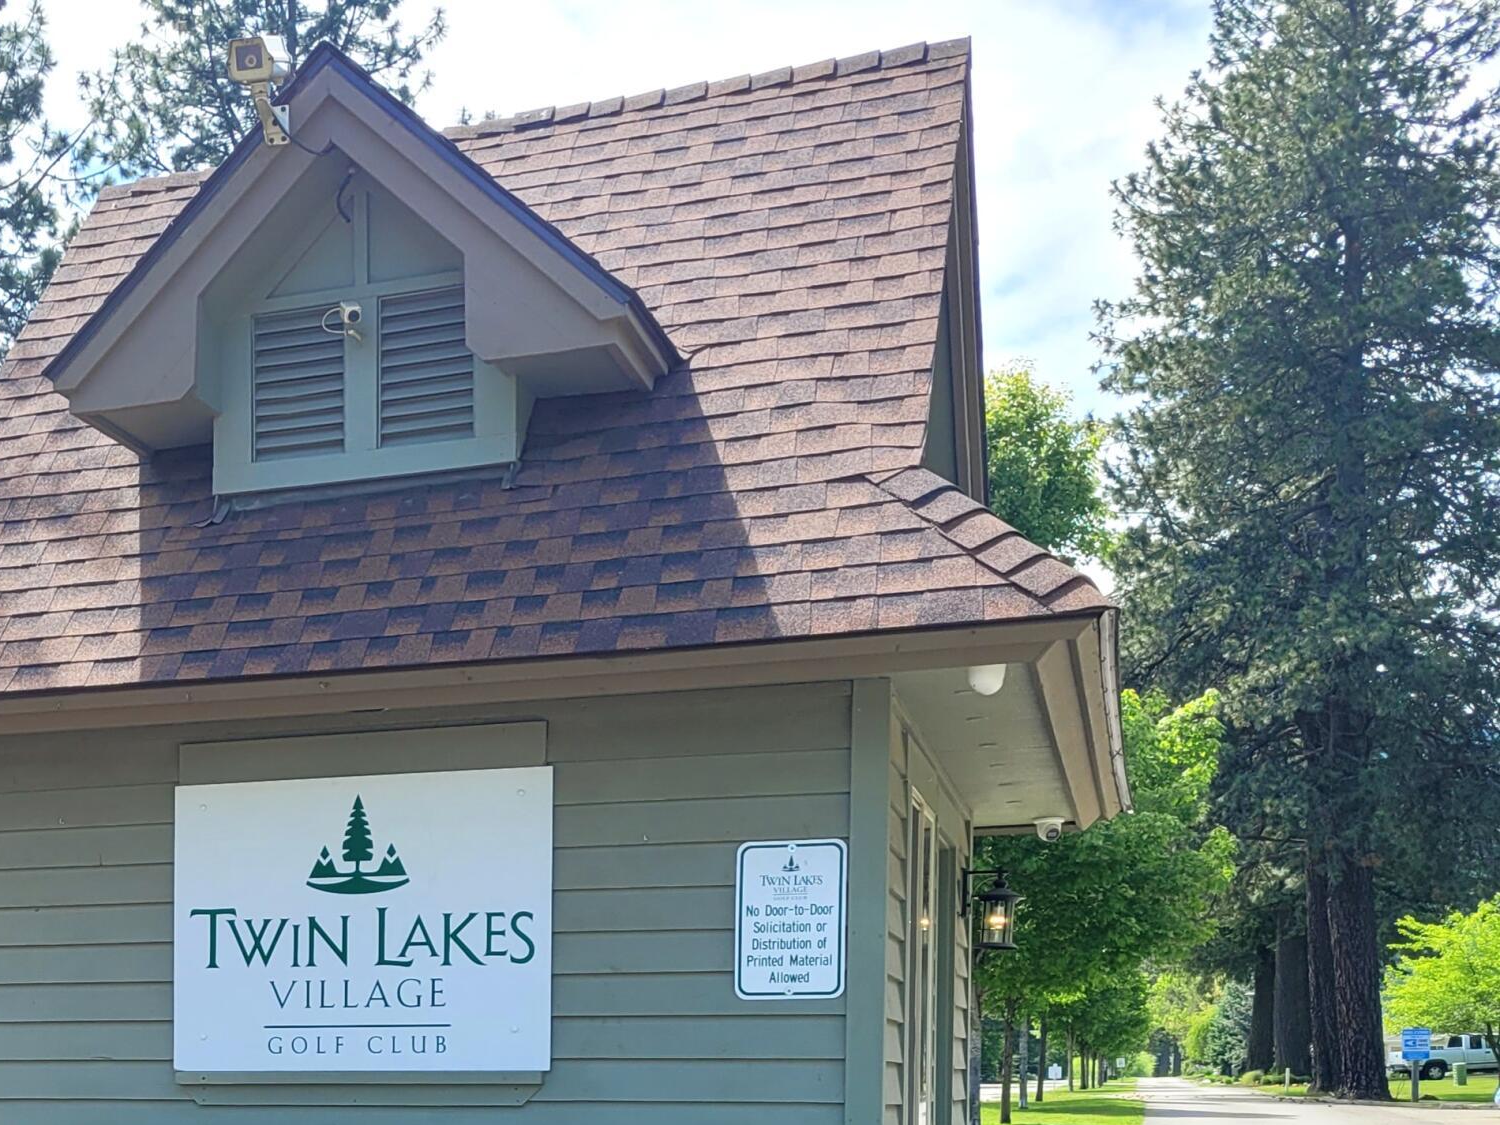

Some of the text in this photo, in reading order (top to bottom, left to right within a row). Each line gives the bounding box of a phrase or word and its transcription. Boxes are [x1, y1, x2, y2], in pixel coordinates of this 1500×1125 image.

[746, 904, 834, 917] No Door-to-Door
[753, 921, 827, 933] Solicitation or
[190, 907, 535, 968] TWIN LAKES
[752, 937, 827, 950] Distribution of
[747, 954, 832, 967] Printed Material
[769, 972, 809, 983] Allowed
[269, 978, 447, 1009] VILLAGE
[267, 1035, 447, 1054] GOLF CLUB
